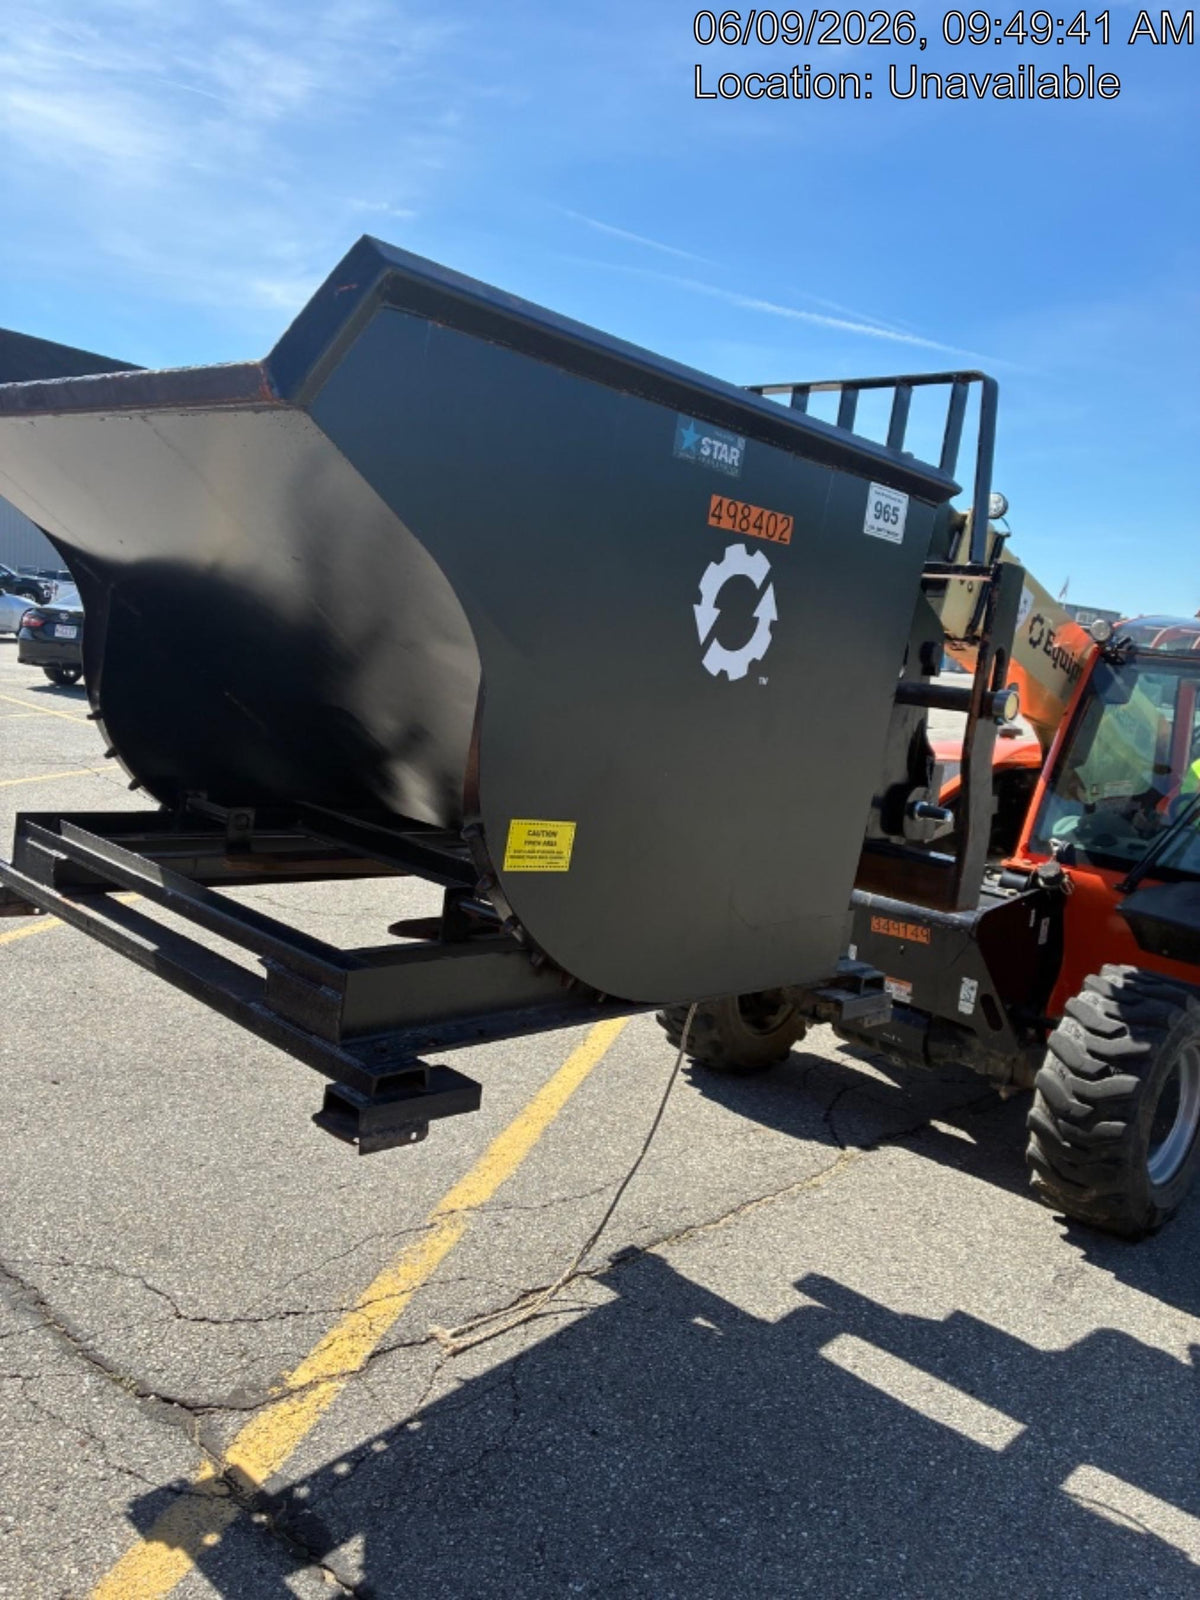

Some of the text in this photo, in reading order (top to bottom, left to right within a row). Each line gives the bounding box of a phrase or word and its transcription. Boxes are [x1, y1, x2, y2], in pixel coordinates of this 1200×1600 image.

[700, 436, 741, 467] STAR
[711, 499, 790, 541] 498402
[873, 500, 899, 525] 965
[527, 829, 558, 838] CAUTION
